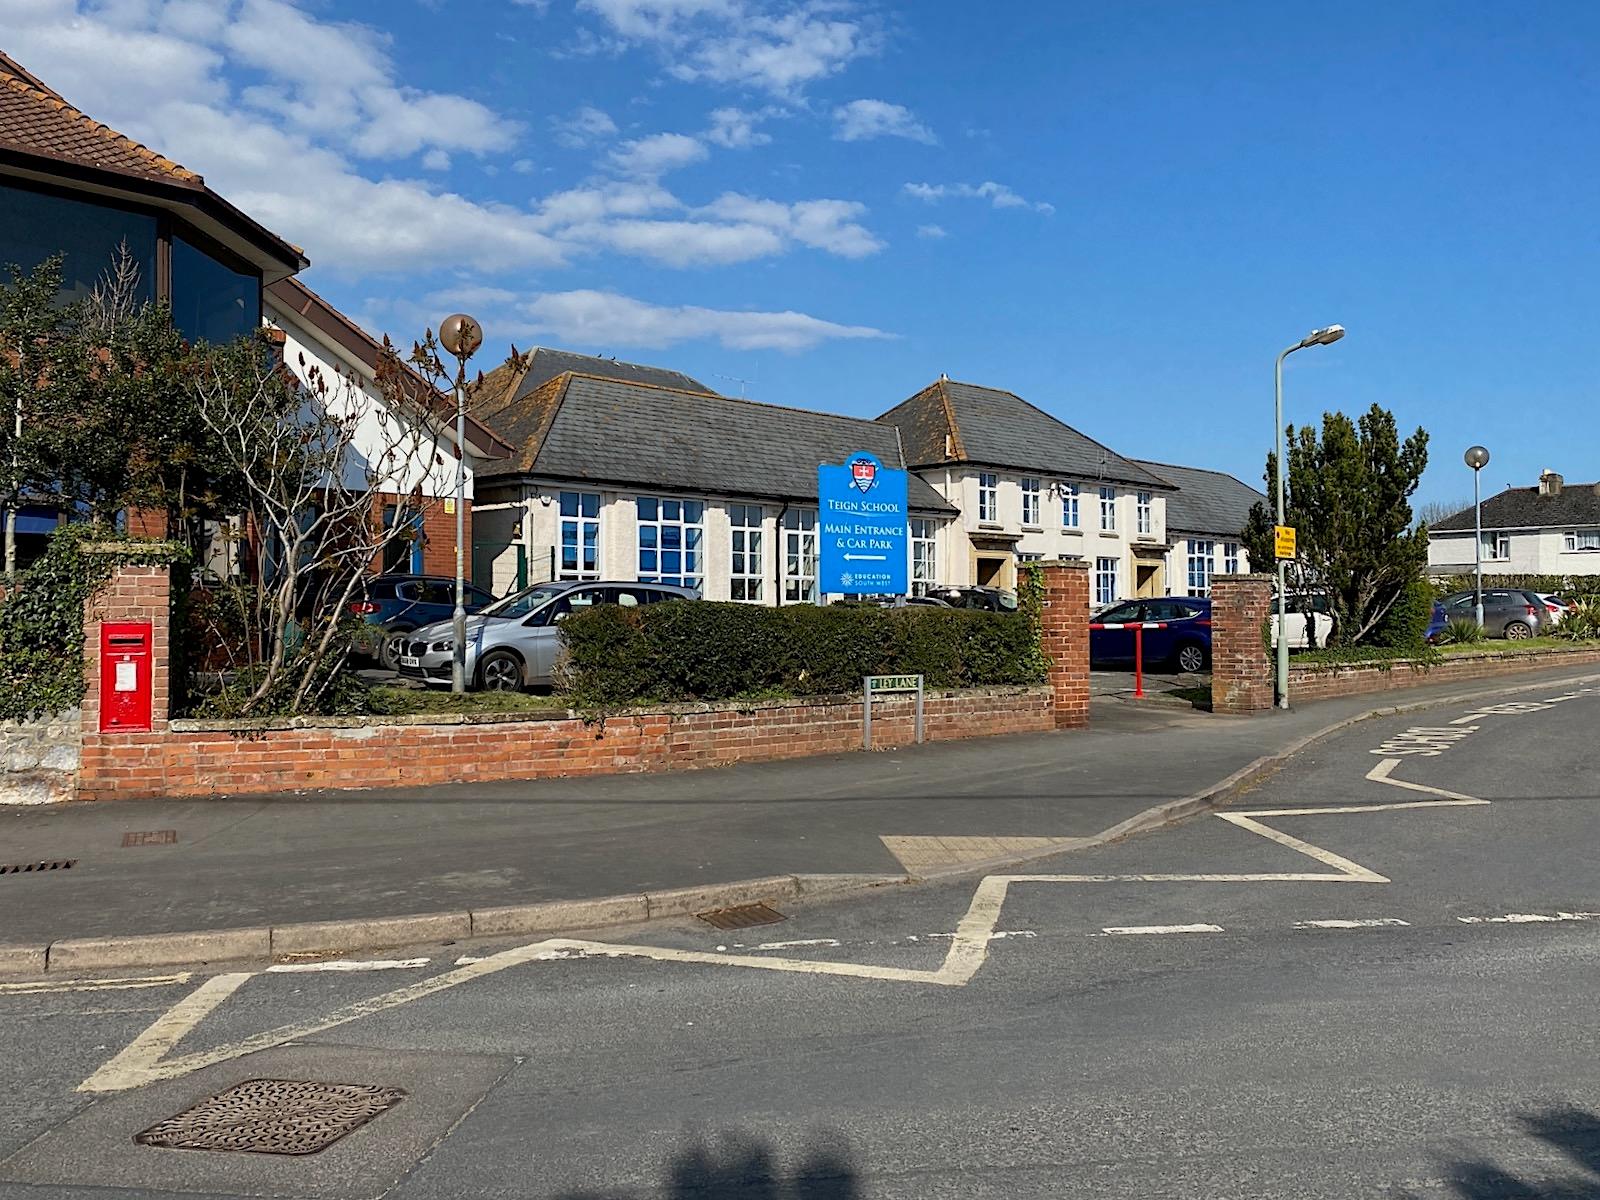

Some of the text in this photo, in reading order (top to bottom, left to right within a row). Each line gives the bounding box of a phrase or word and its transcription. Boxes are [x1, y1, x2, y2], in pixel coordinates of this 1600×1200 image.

[828, 499, 900, 513] TEIGN SCHOOL
[824, 523, 904, 536] MAIN ENTRANCE
[836, 538, 893, 550] & CAR PARK
[880, 677, 917, 689] LEY LANE
